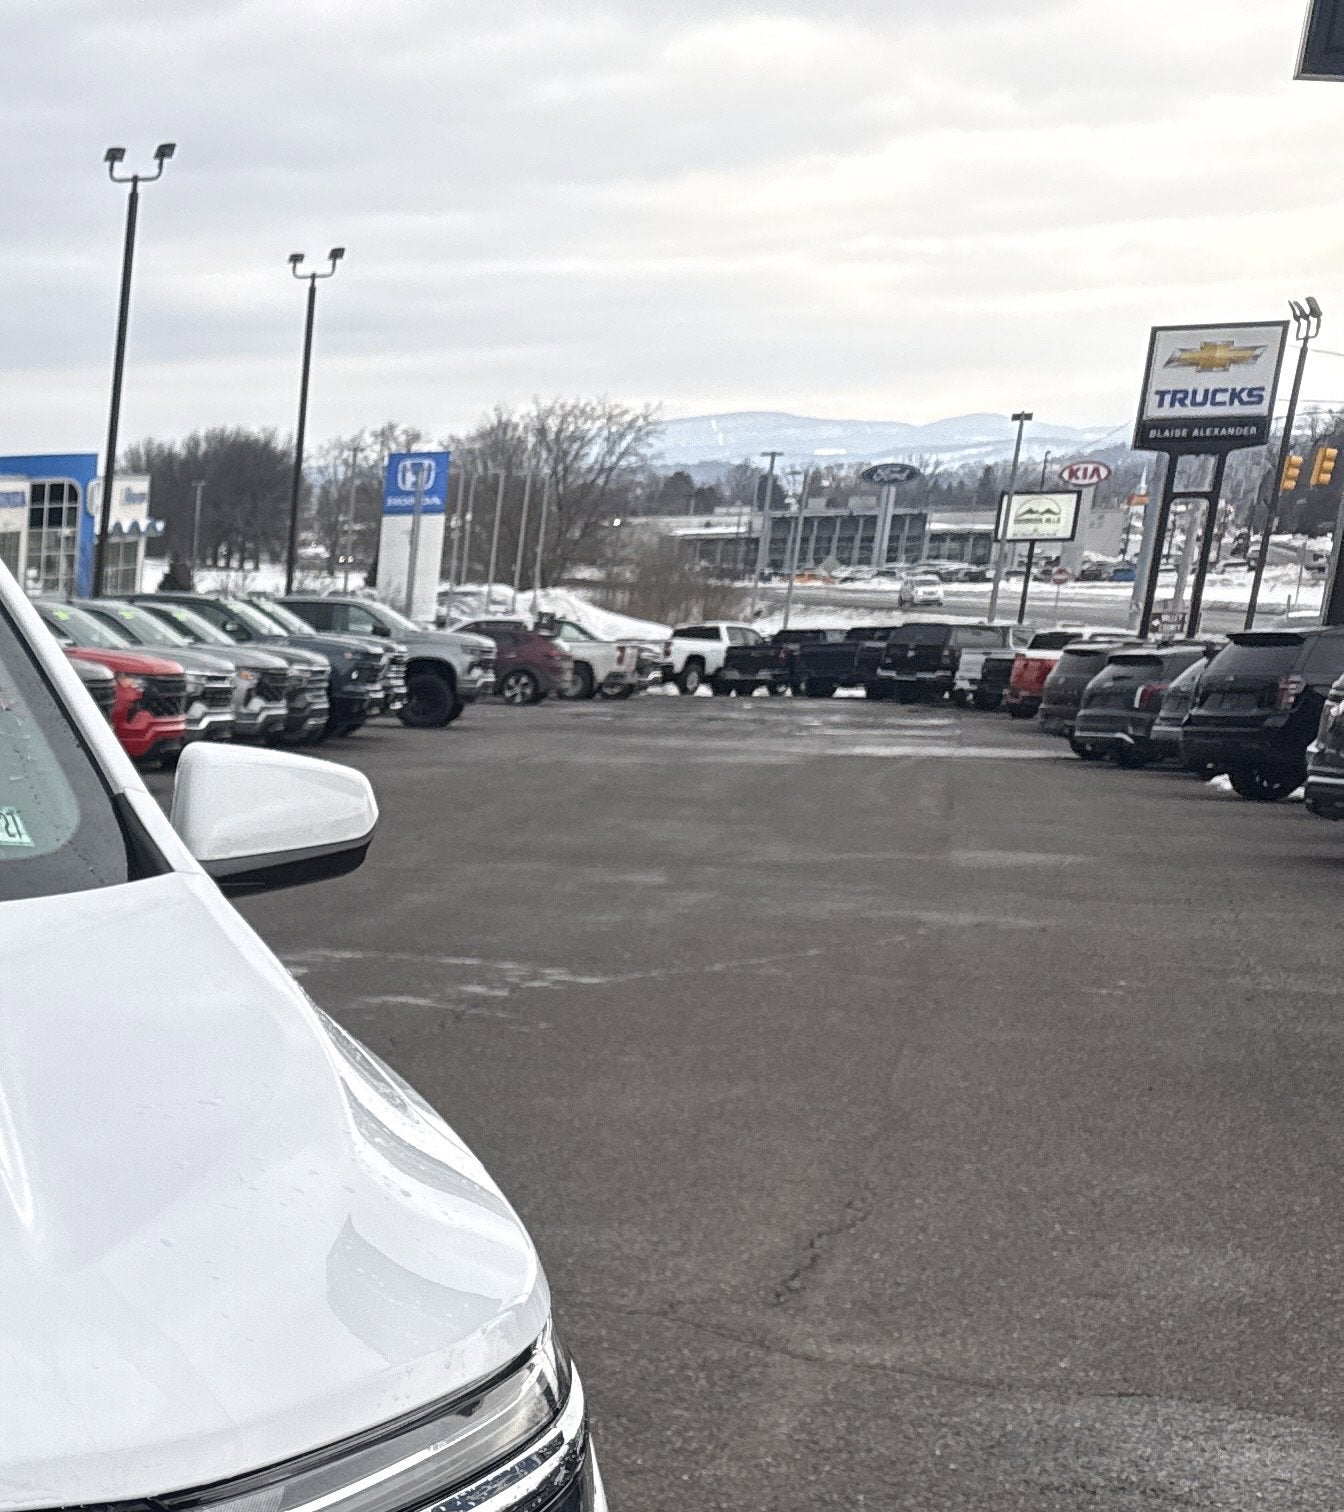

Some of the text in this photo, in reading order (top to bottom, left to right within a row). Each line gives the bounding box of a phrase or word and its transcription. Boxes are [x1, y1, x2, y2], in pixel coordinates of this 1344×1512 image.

[1154, 386, 1265, 408] TRUCKS
[1149, 426, 1257, 439] BLAISE ALEXANDER
[1068, 466, 1102, 480] KIA
